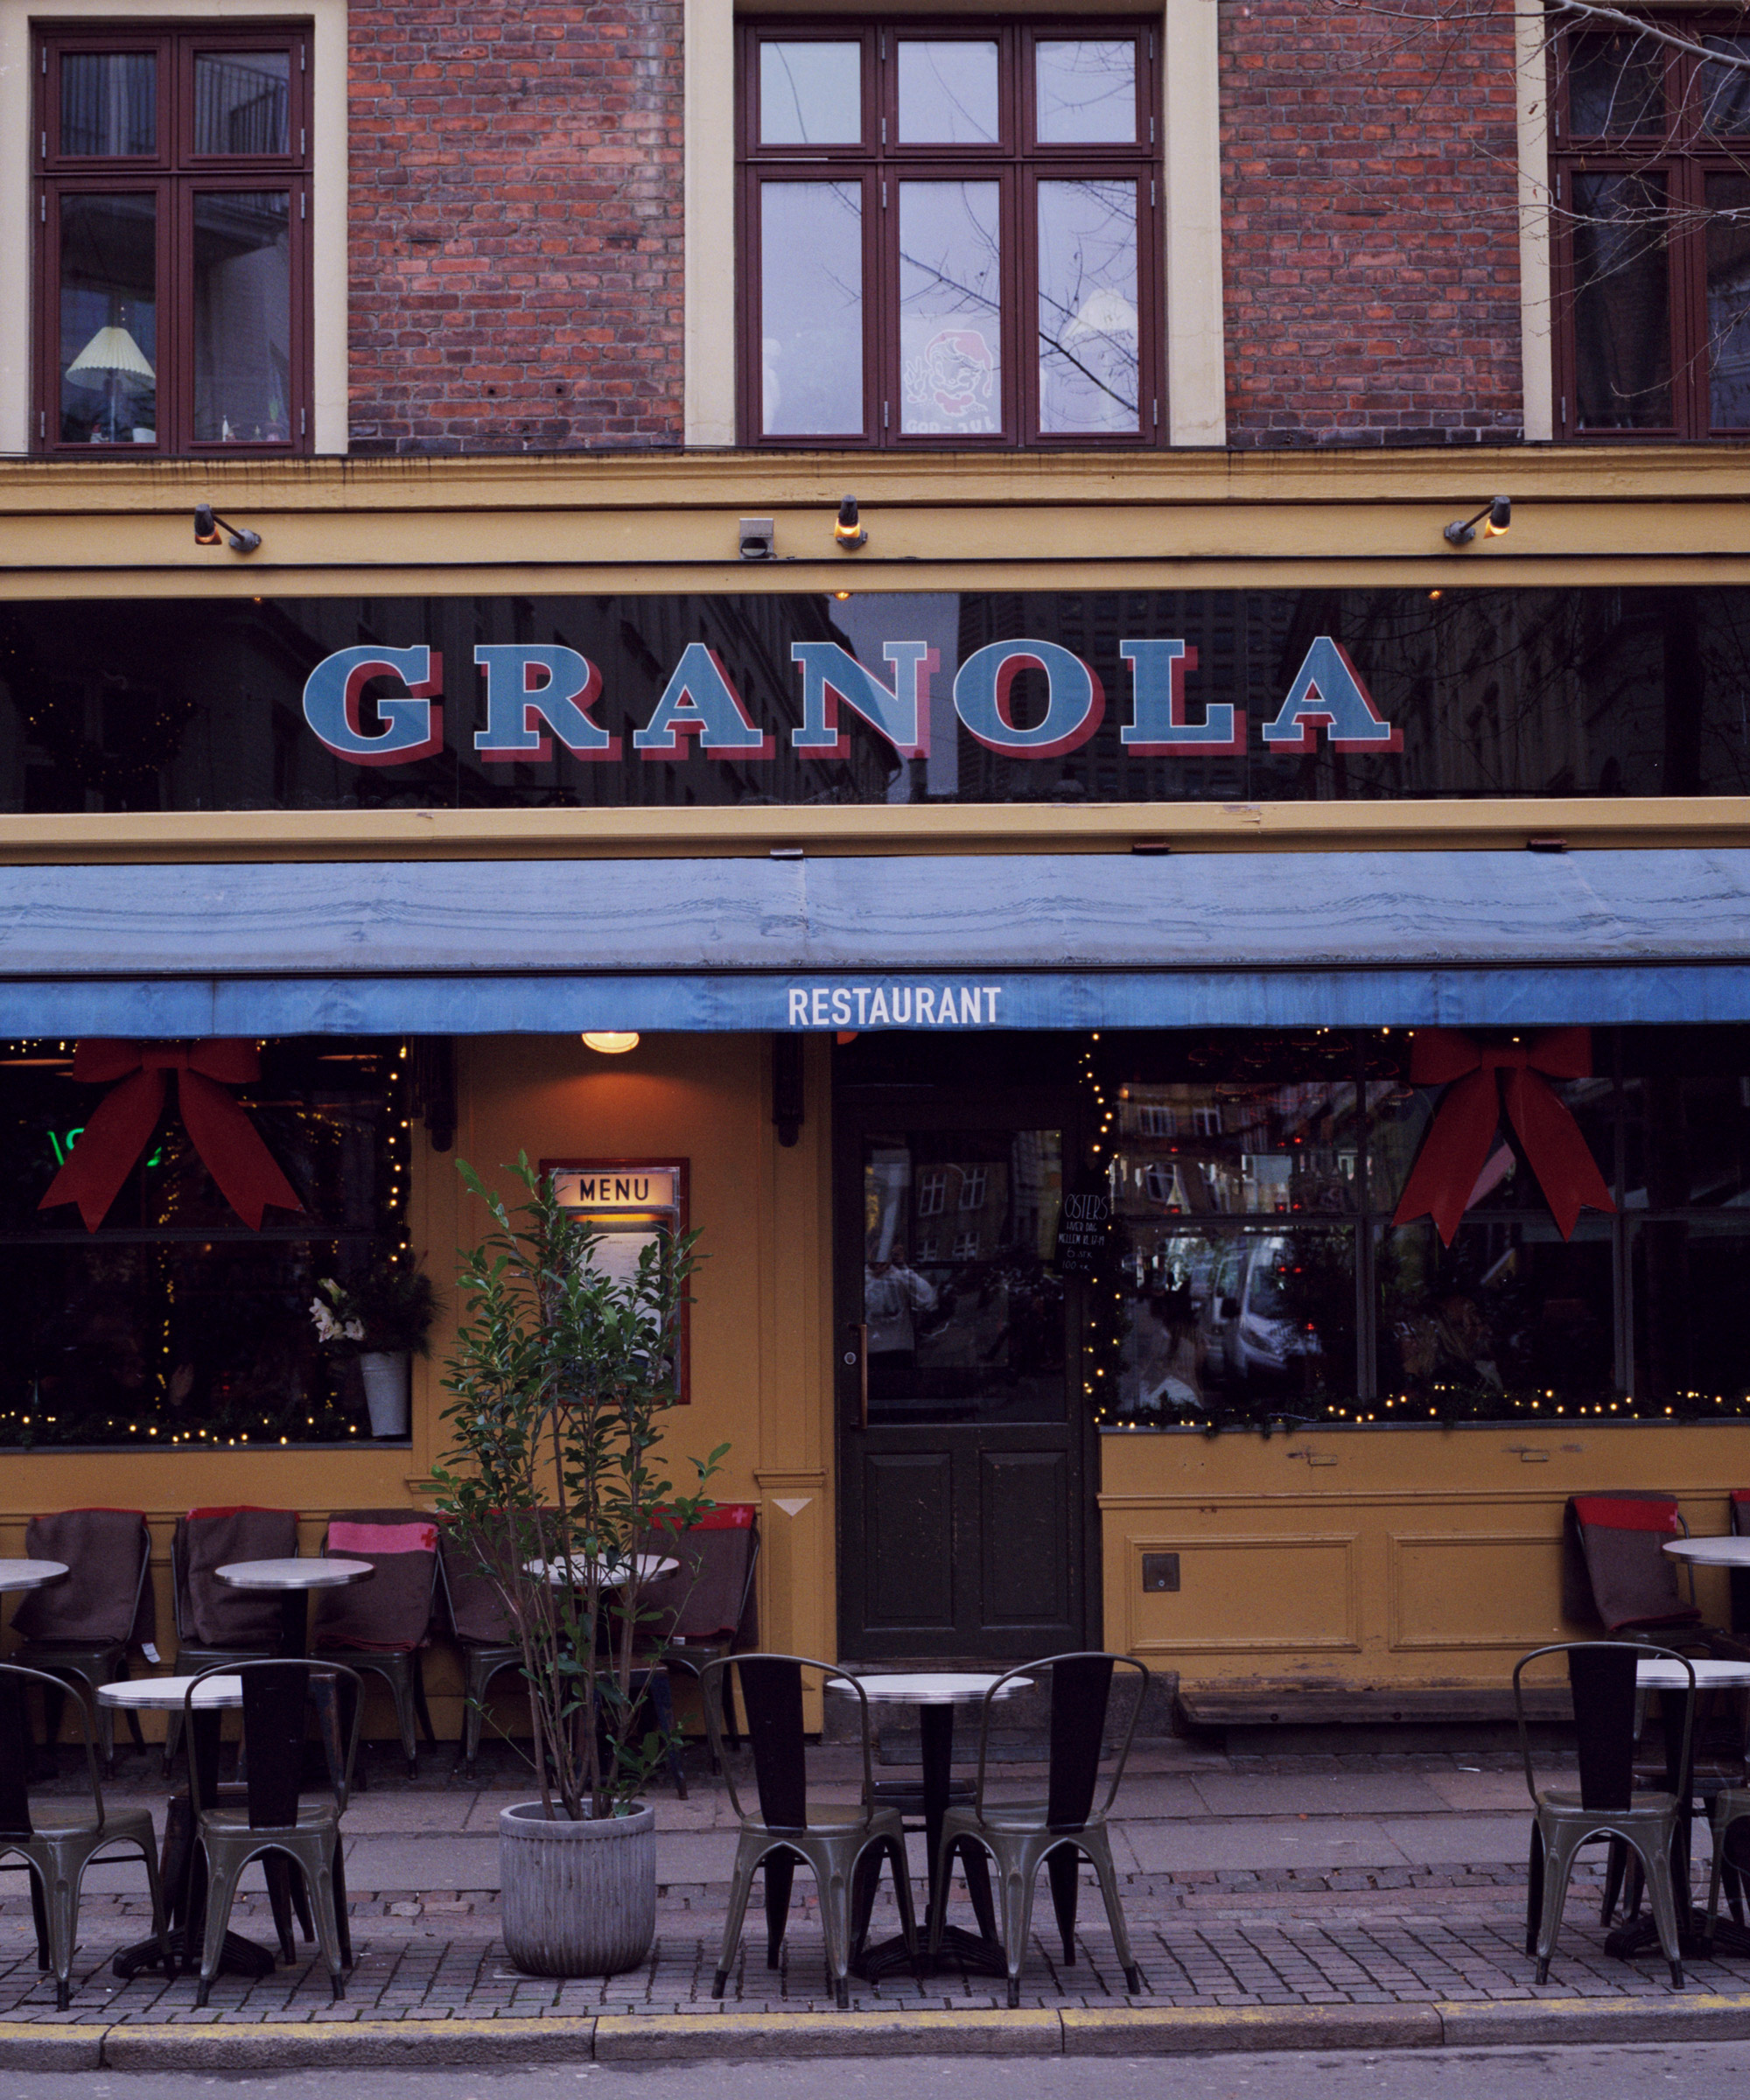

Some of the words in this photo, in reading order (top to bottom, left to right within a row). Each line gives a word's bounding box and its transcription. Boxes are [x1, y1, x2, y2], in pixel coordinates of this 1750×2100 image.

[906, 419, 941, 433] GOD
[302, 635, 1404, 763] GRANOLA
[789, 987, 1001, 1025] RESTAURANT
[580, 1178, 648, 1200] MENU
[1067, 1246, 1075, 1258] 6
[1062, 1260, 1077, 1270] 100
